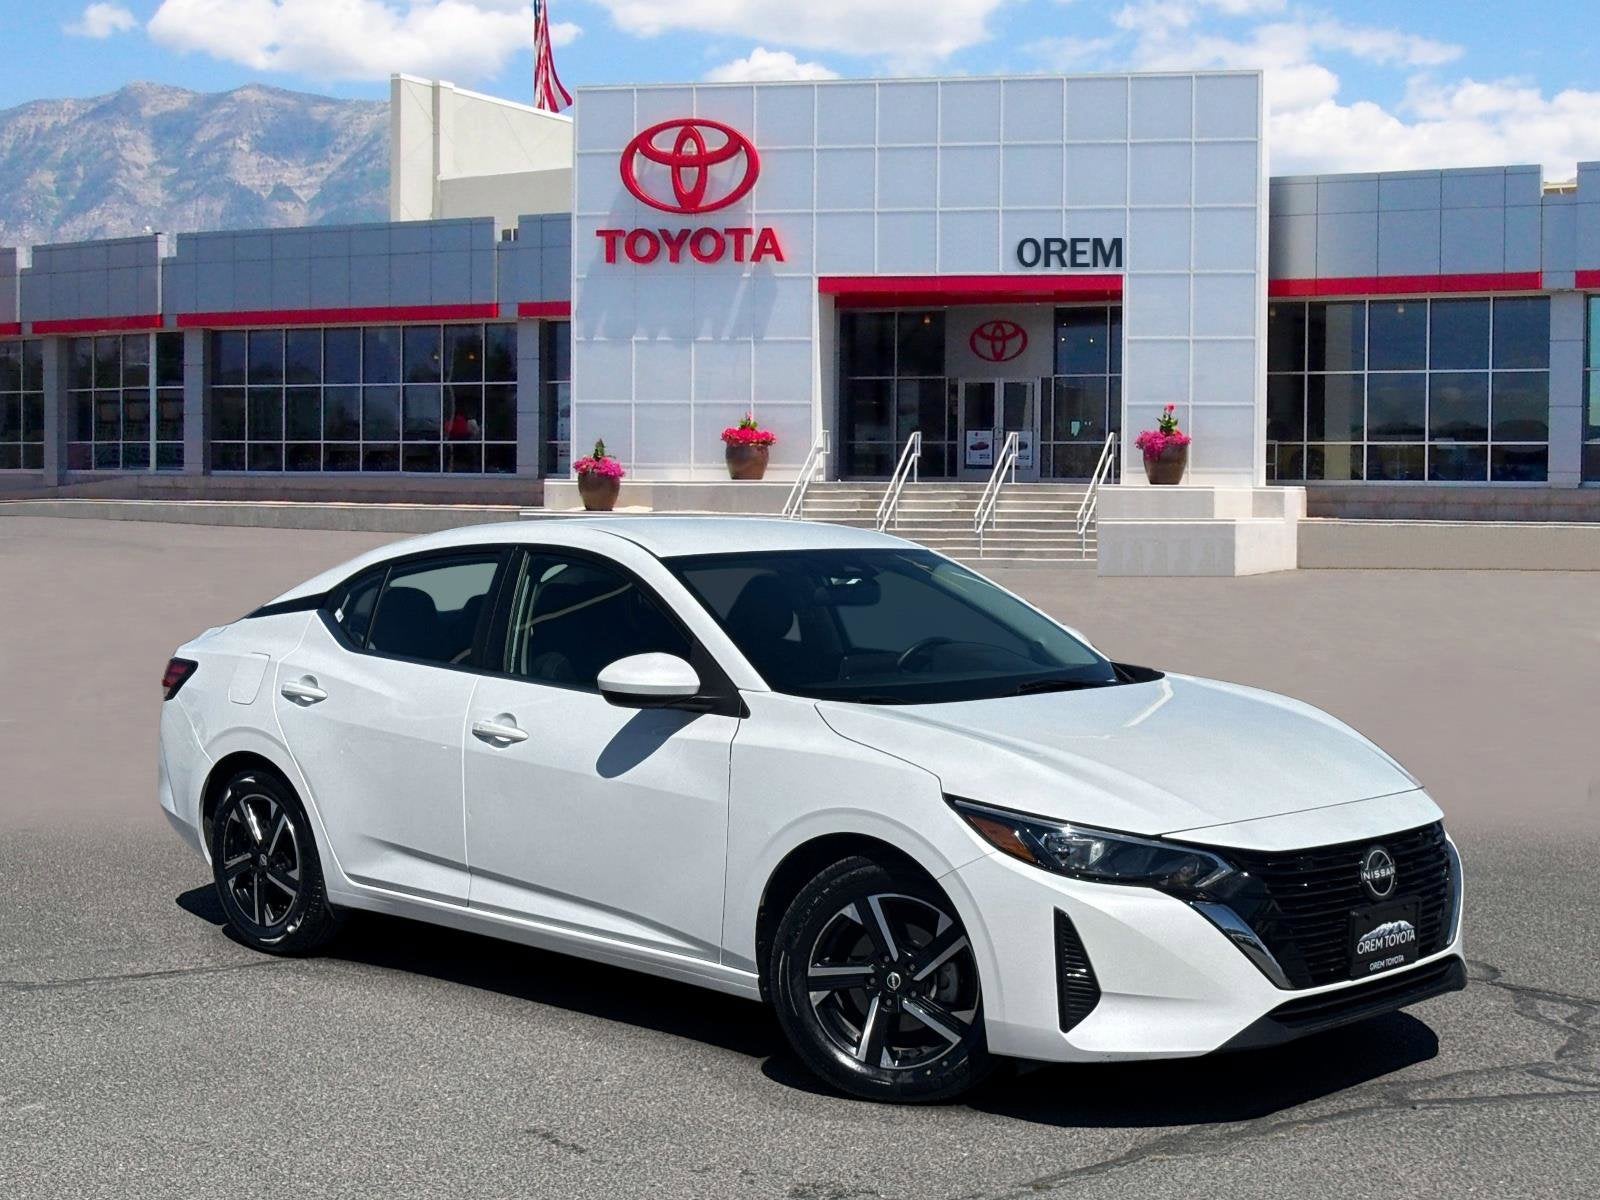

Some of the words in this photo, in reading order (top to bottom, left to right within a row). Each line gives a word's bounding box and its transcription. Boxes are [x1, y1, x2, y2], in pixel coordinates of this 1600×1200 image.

[596, 227, 784, 264] TOYOTA
[1016, 237, 1123, 269] OREM
[1362, 867, 1395, 880] NISSAN
[1357, 938, 1384, 954] OREM
[1385, 929, 1415, 946] TOYOTA
[1369, 960, 1385, 971] OREM
[1386, 955, 1404, 966] TOYOTA
